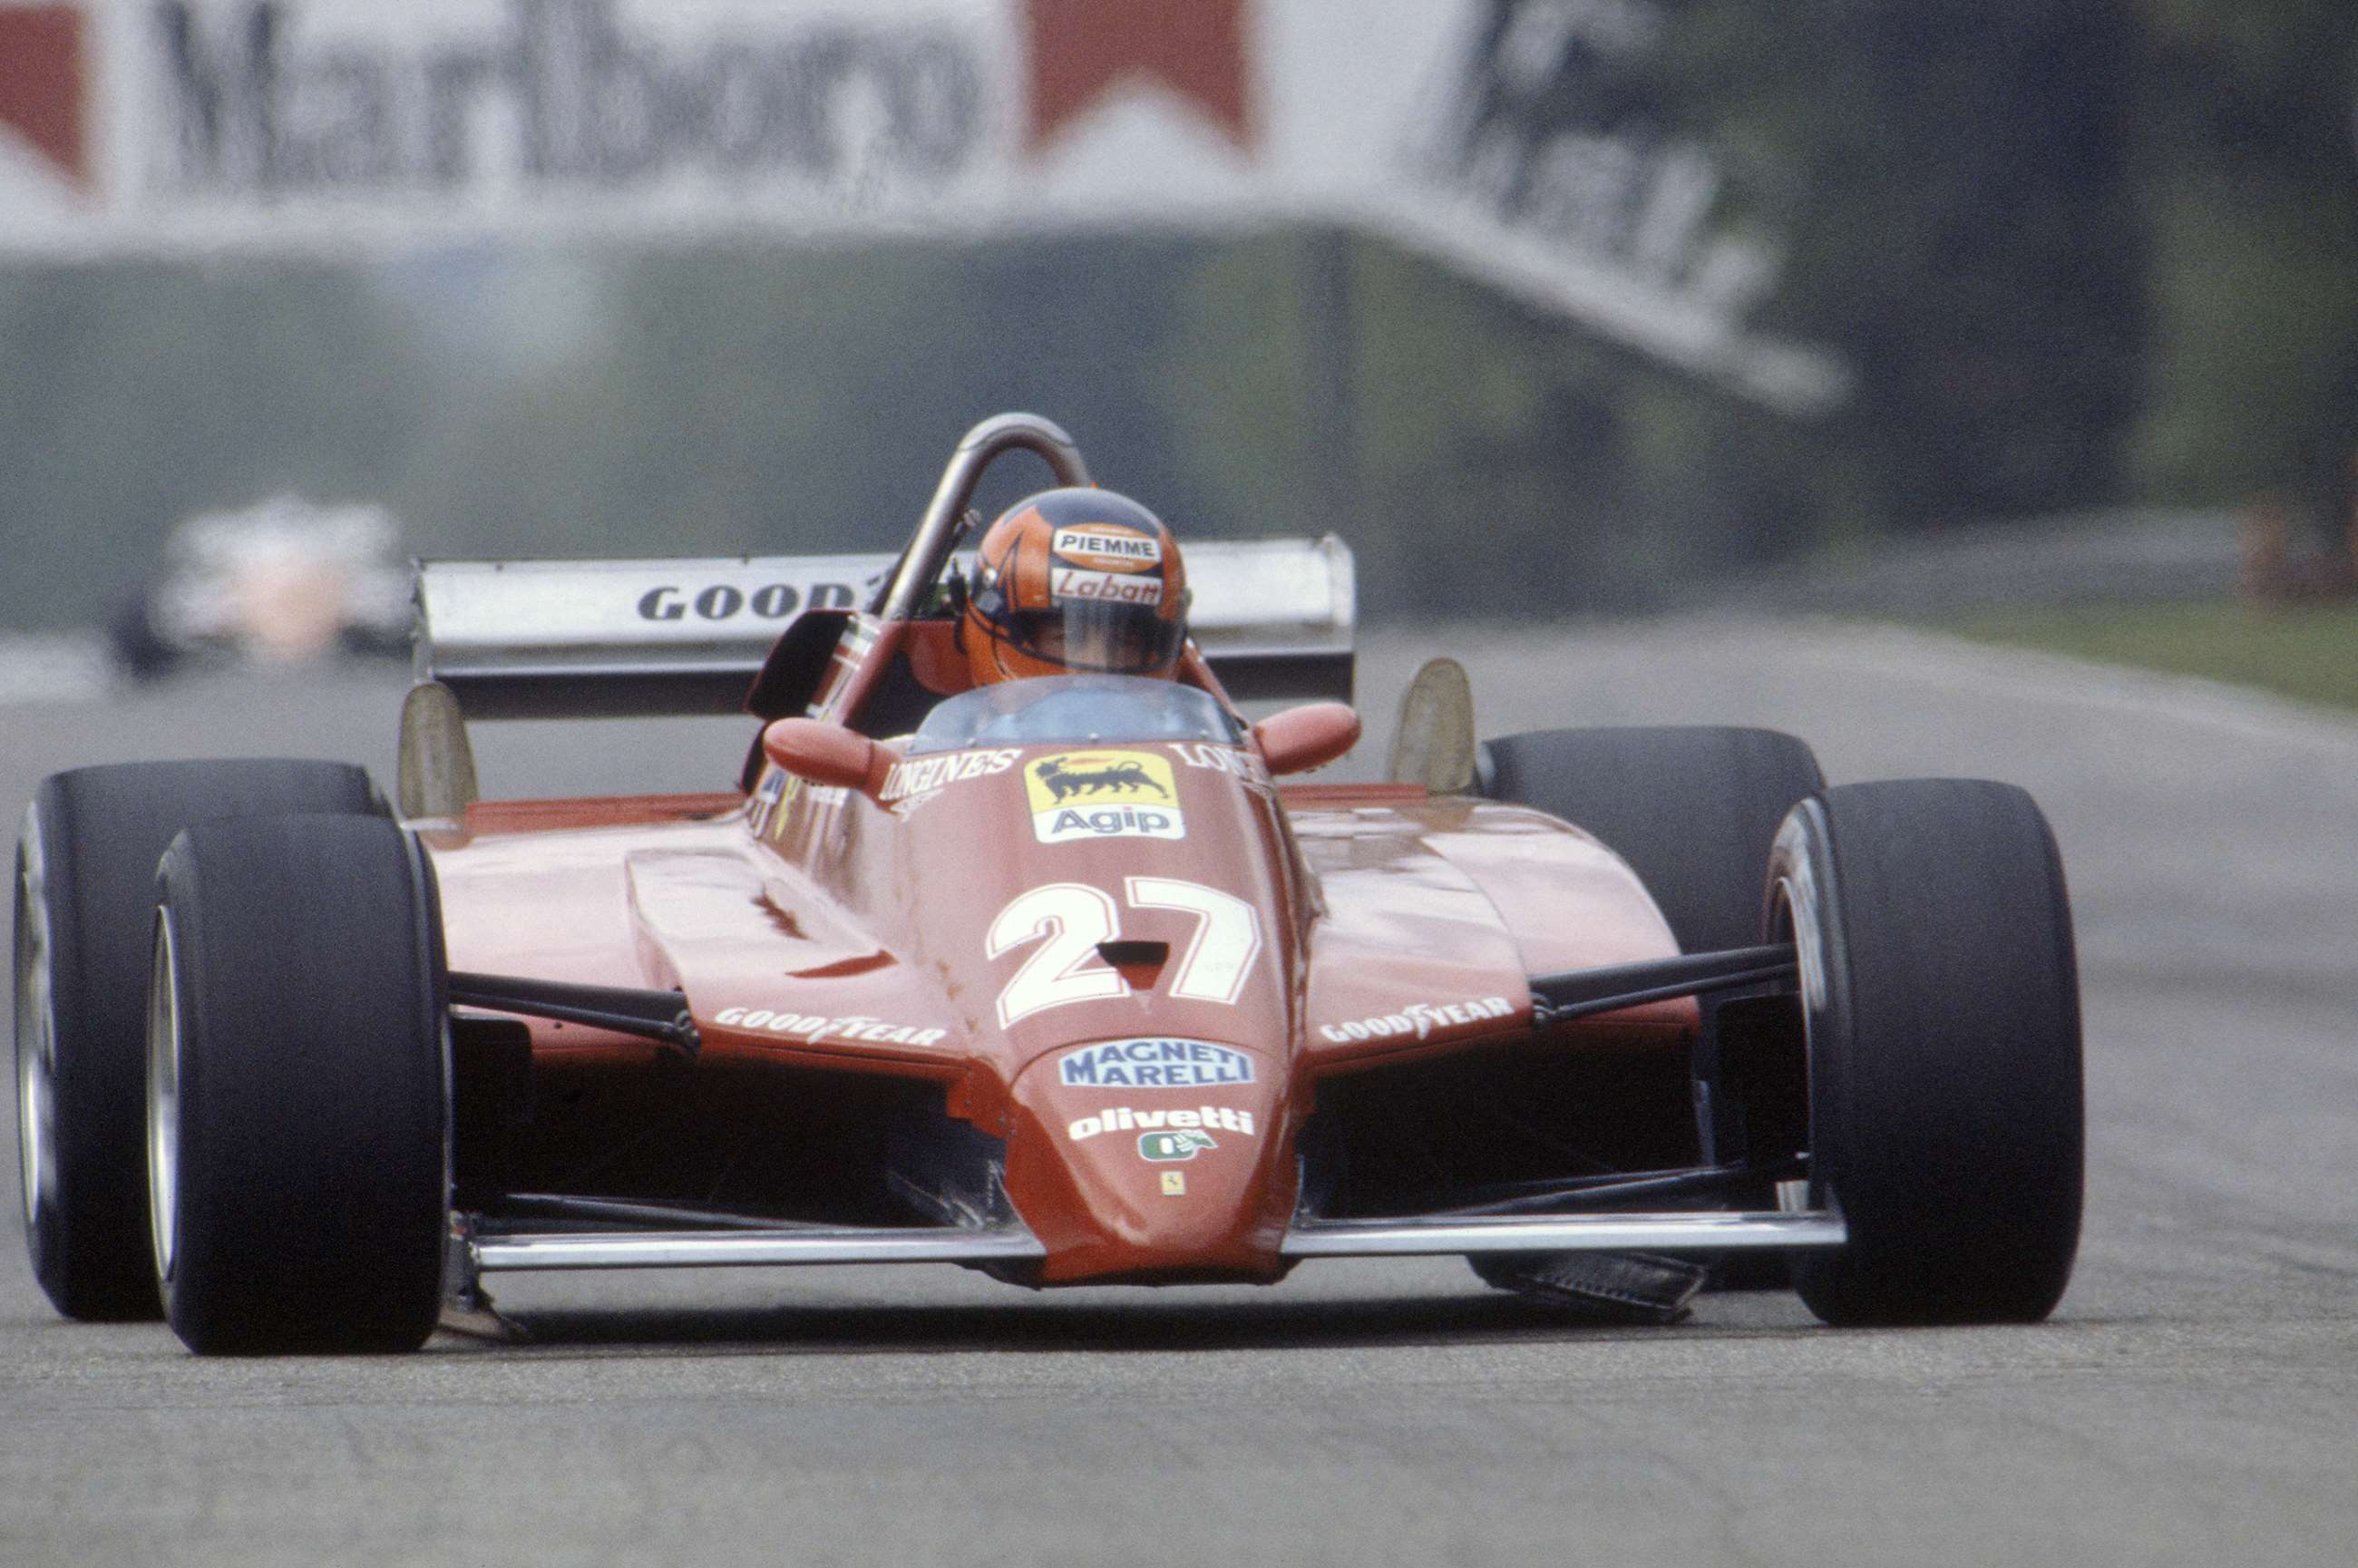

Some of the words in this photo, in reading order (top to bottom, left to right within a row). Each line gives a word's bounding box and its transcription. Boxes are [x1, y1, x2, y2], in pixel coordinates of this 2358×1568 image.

[1060, 535, 1155, 557] PIEMME
[879, 748, 1024, 802] LONGINES
[1051, 805, 1170, 834] Agip
[985, 875, 1262, 1031] 27
[714, 1007, 947, 1045] GOODYEAR
[1320, 997, 1515, 1040] GOODYEAR
[1065, 1041, 1251, 1074] MAGNETI
[1065, 1056, 1251, 1086] MARELLI
[1068, 1105, 1255, 1141] olivetti
